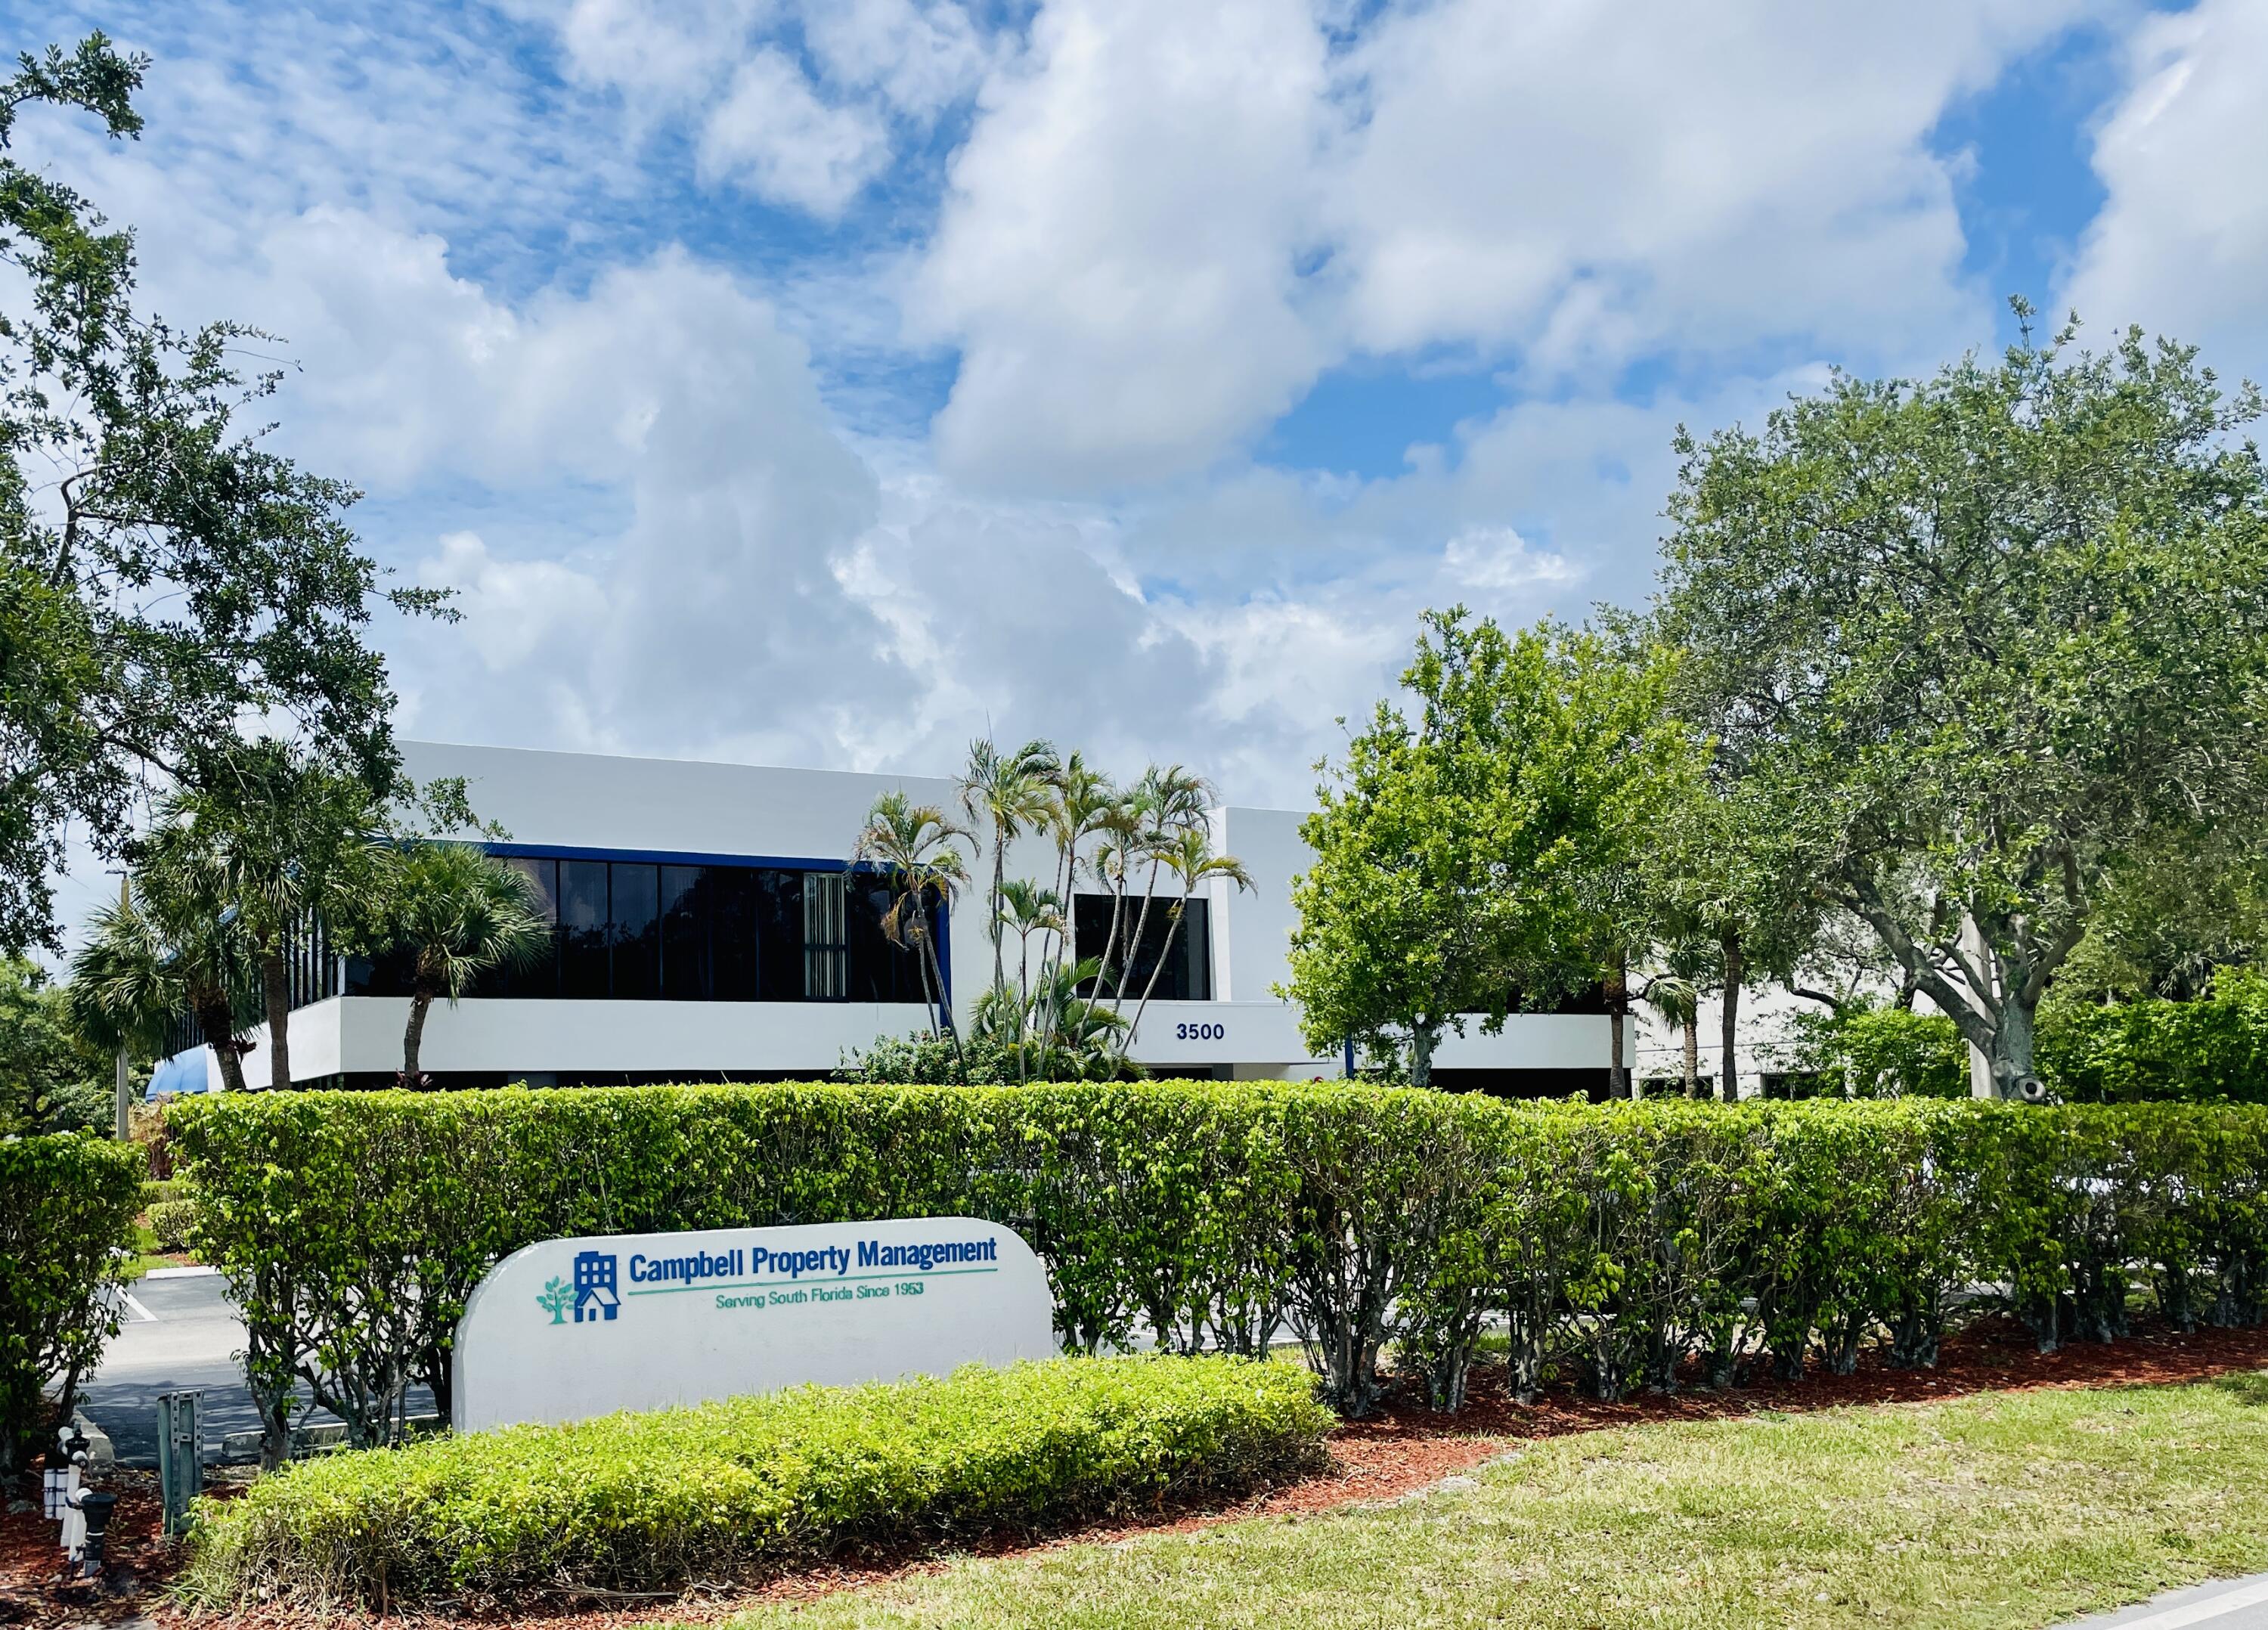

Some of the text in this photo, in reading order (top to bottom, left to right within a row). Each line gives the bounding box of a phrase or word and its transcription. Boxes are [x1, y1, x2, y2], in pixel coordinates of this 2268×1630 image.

[1177, 1023, 1225, 1040] 3500
[630, 1238, 997, 1284] Campbell Property Management
[716, 1281, 924, 1309] Serving South Florida Since 1953
